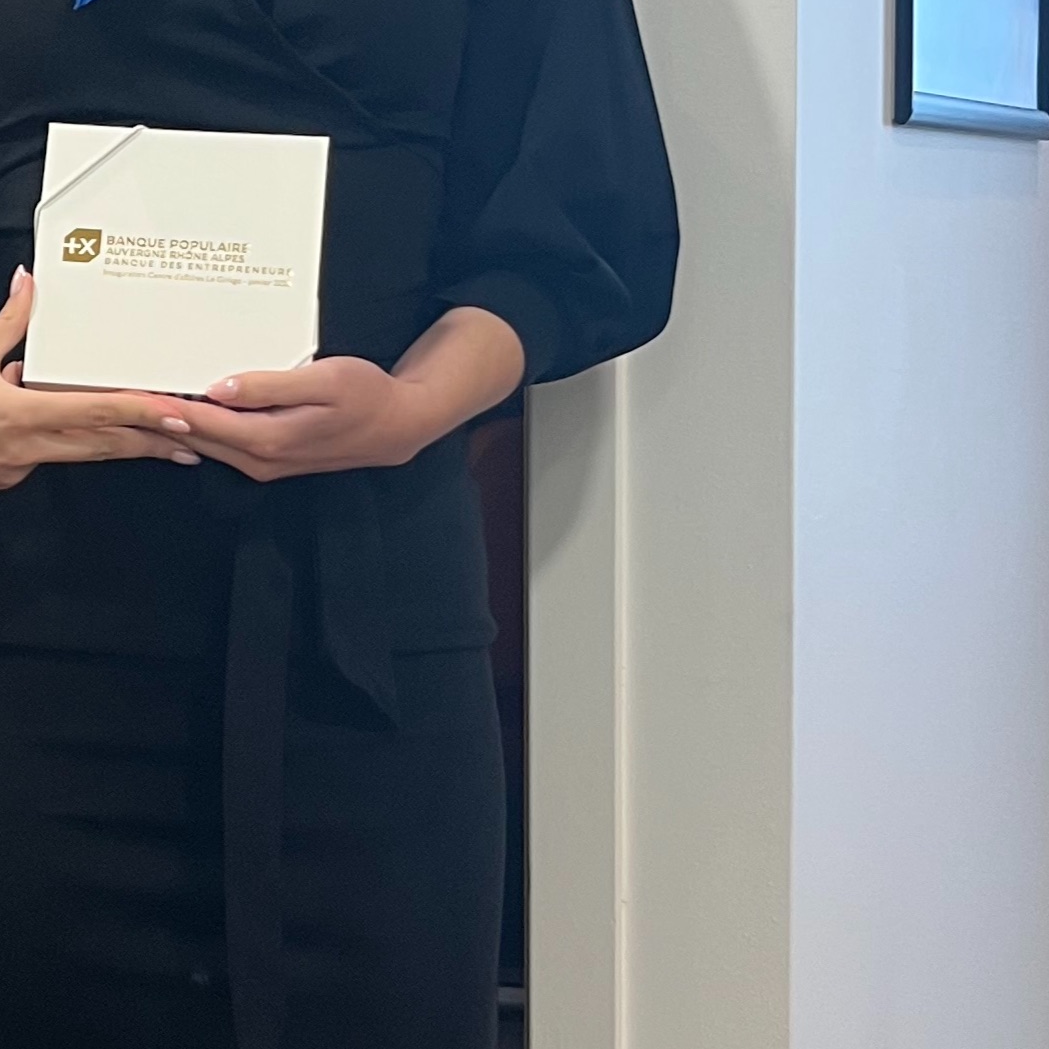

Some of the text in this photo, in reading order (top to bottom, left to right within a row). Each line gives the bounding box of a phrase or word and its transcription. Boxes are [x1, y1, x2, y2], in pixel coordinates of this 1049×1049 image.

[106, 235, 249, 254] BANQUE POPULAIRE
[104, 257, 154, 268] BANQUE
[160, 261, 182, 270] DES
[106, 247, 166, 259] AUVERGNE
[210, 253, 245, 264] ALPES
